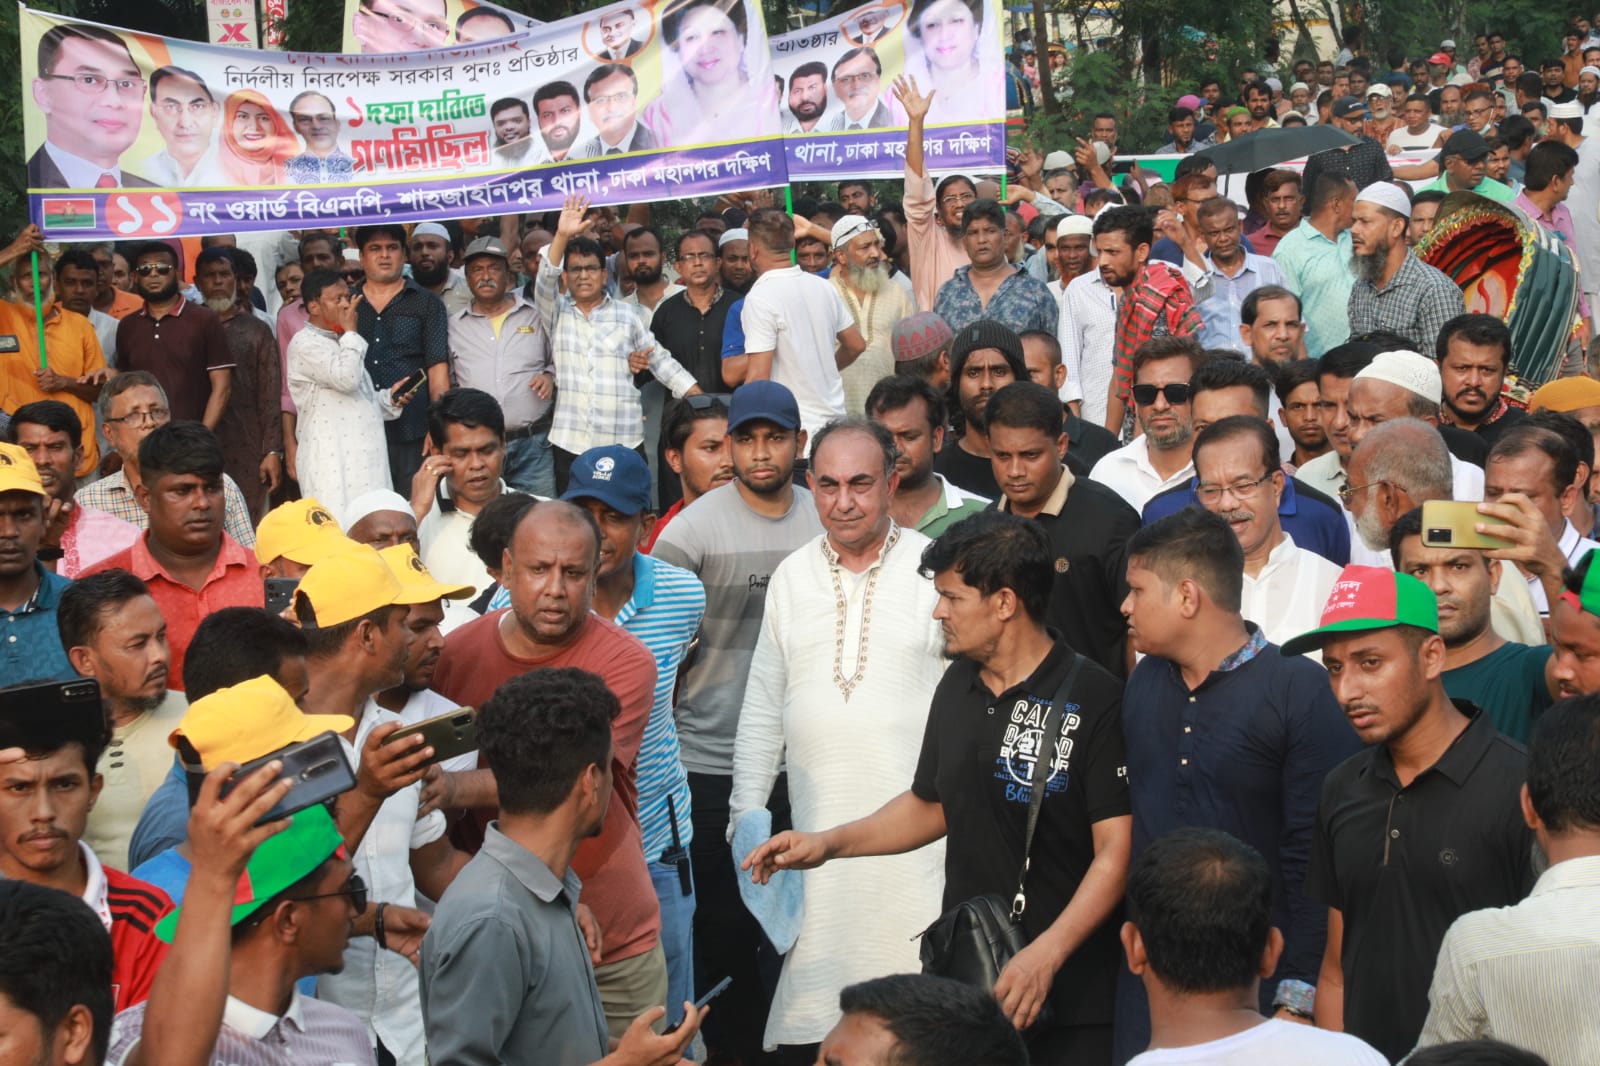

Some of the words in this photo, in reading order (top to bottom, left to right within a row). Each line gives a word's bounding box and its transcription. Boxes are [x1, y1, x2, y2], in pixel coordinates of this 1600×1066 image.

[224, 65, 294, 88] নির্দলীয়
[302, 66, 381, 88] নিরপেক্ষ
[388, 64, 453, 85] সরকার
[508, 45, 579, 72] প্রতিষ্ঠার
[346, 96, 364, 128] ১
[366, 101, 414, 125] দফা
[417, 88, 486, 122] দাবিতে
[350, 124, 489, 172] গণমিছিল
[948, 131, 992, 156] দক্ষিণ
[116, 195, 177, 234] ১১
[186, 201, 220, 225] নং
[226, 191, 291, 221] ওয়ার্ড
[296, 187, 391, 218] বিএনপি,
[396, 177, 545, 212] শাহজাহানপুর
[653, 158, 719, 184] মহানগর
[724, 150, 772, 176] দক্ষিণ
[1011, 700, 1081, 735] CAP
